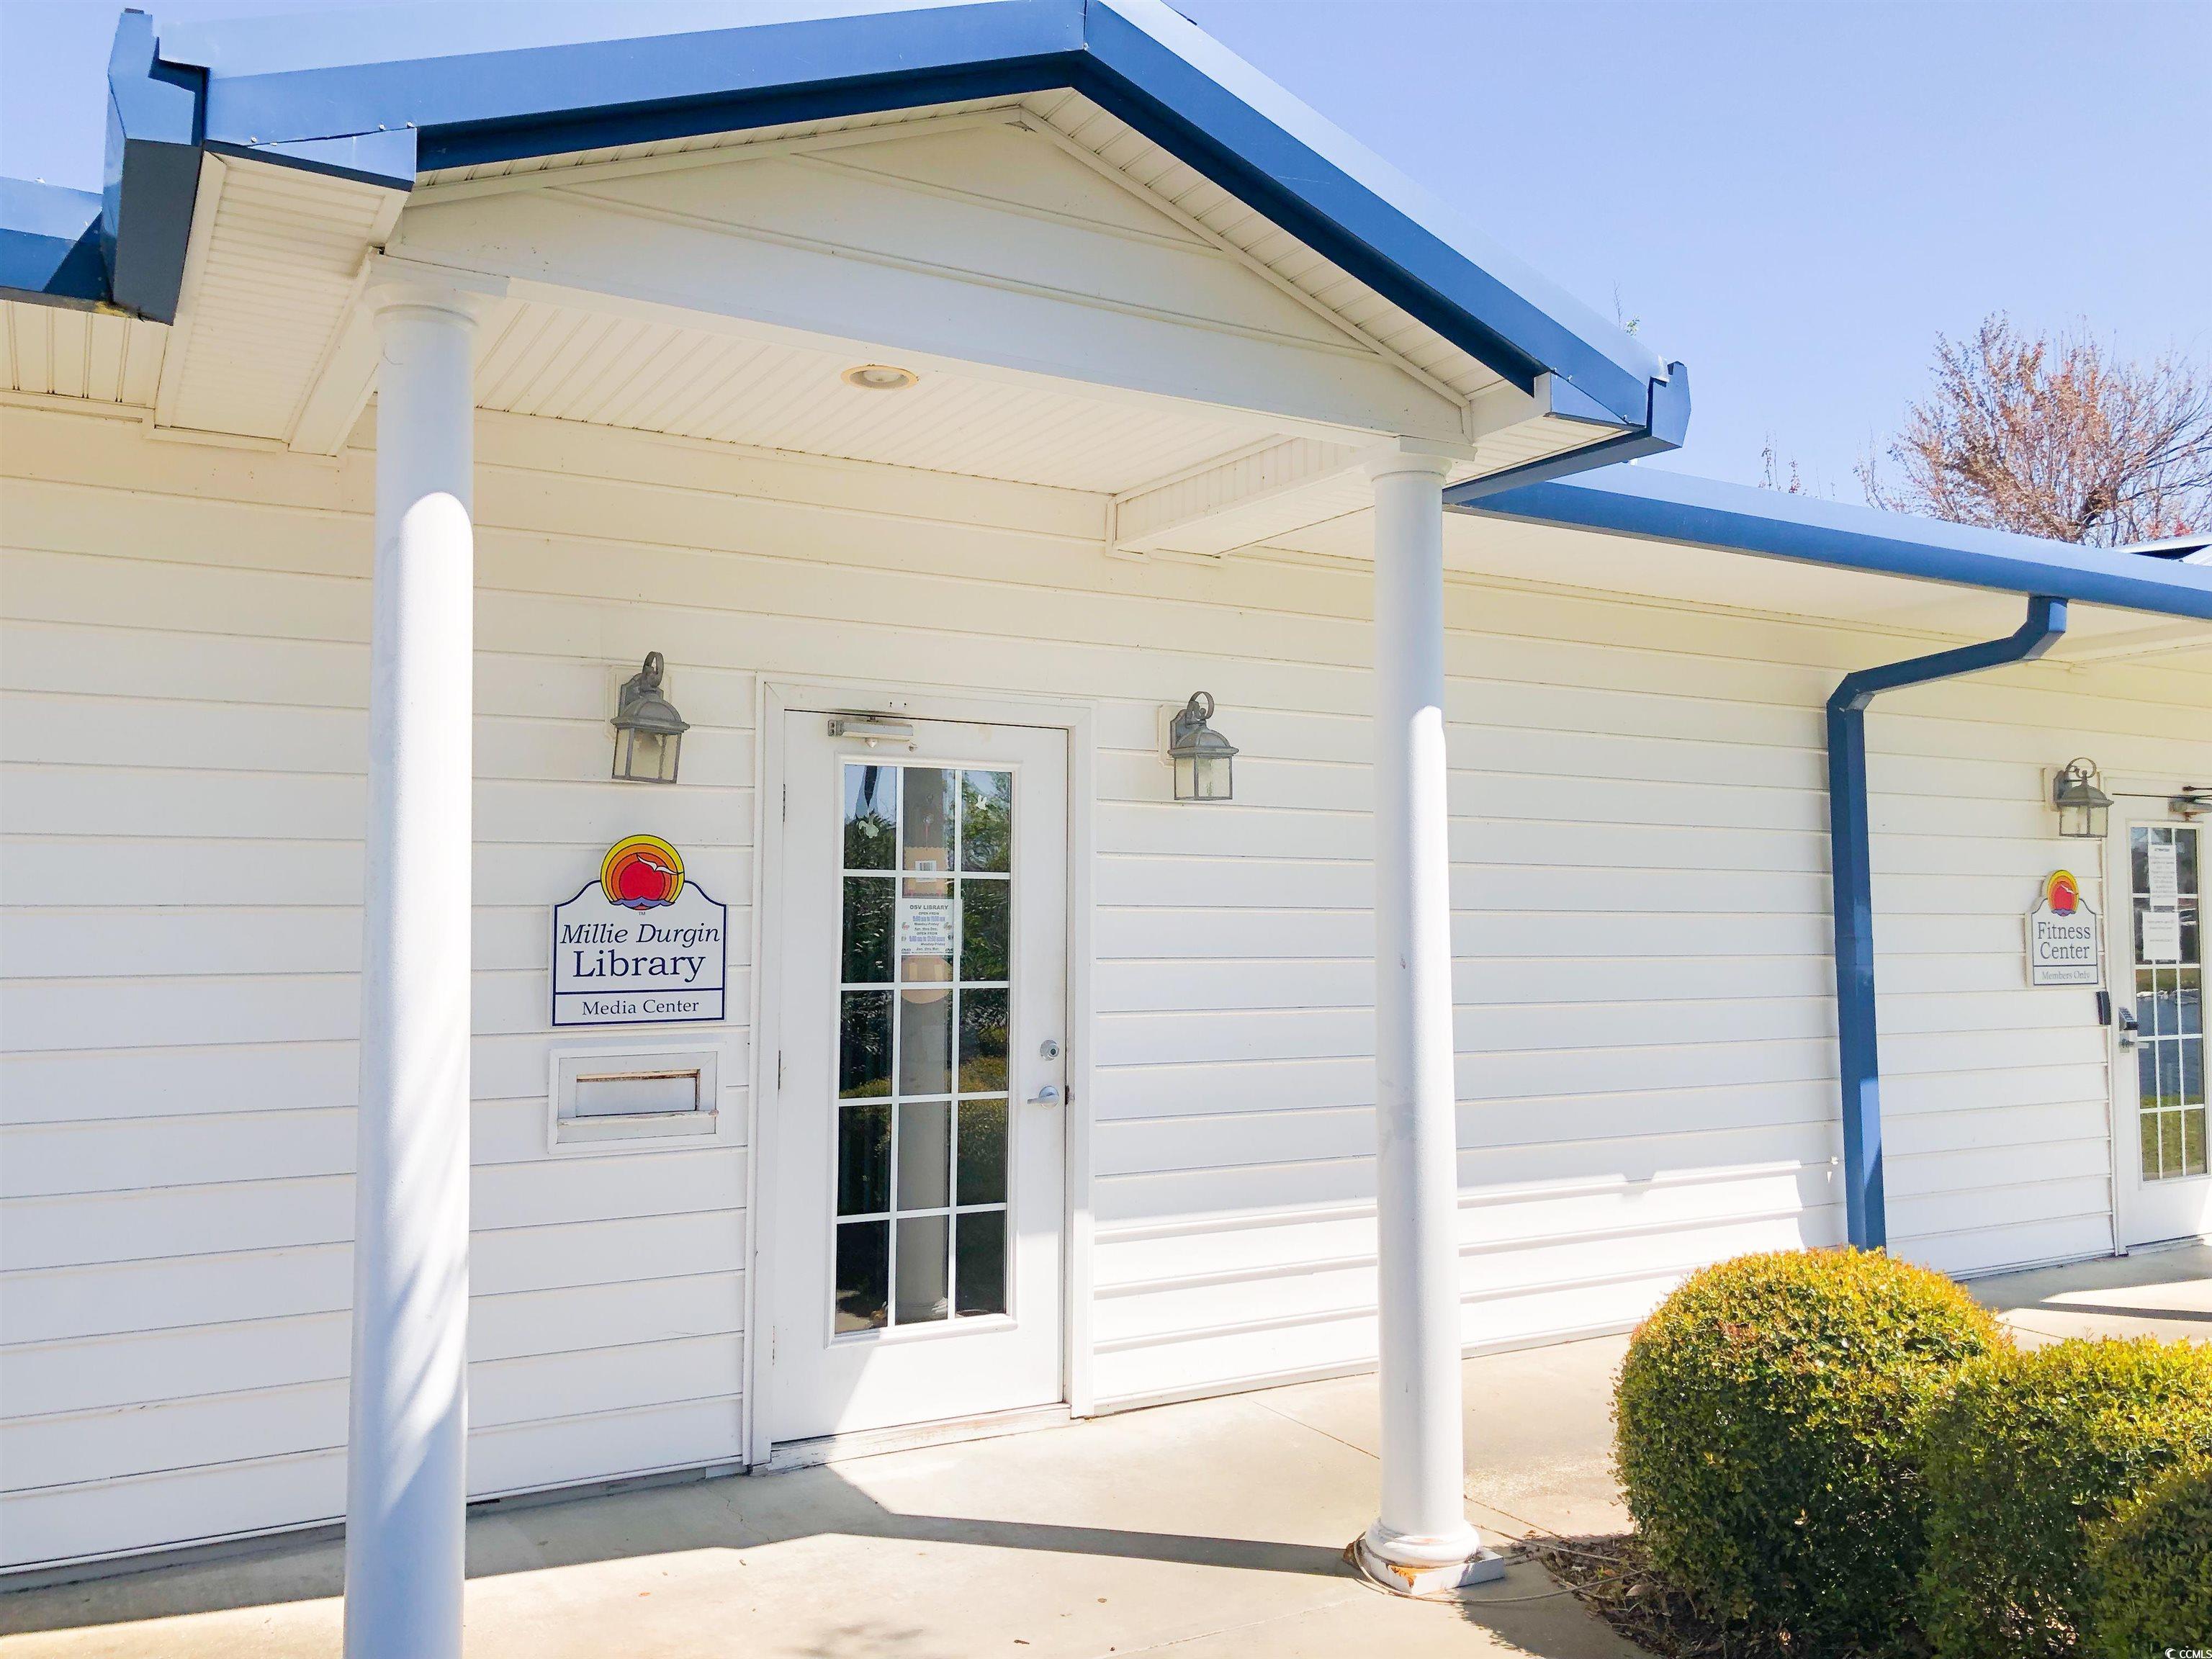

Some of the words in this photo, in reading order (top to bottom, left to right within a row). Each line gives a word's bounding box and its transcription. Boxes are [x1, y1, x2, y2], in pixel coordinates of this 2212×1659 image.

[560, 923, 629, 944] Millie
[636, 922, 720, 948] Durgin
[2037, 922, 2091, 940] Fitness
[2040, 942, 2090, 960] Center
[572, 949, 706, 983] Library
[2042, 971, 2073, 980] Members
[2074, 970, 2090, 980] Only
[582, 1000, 637, 1015] Media
[642, 999, 699, 1014] Center
